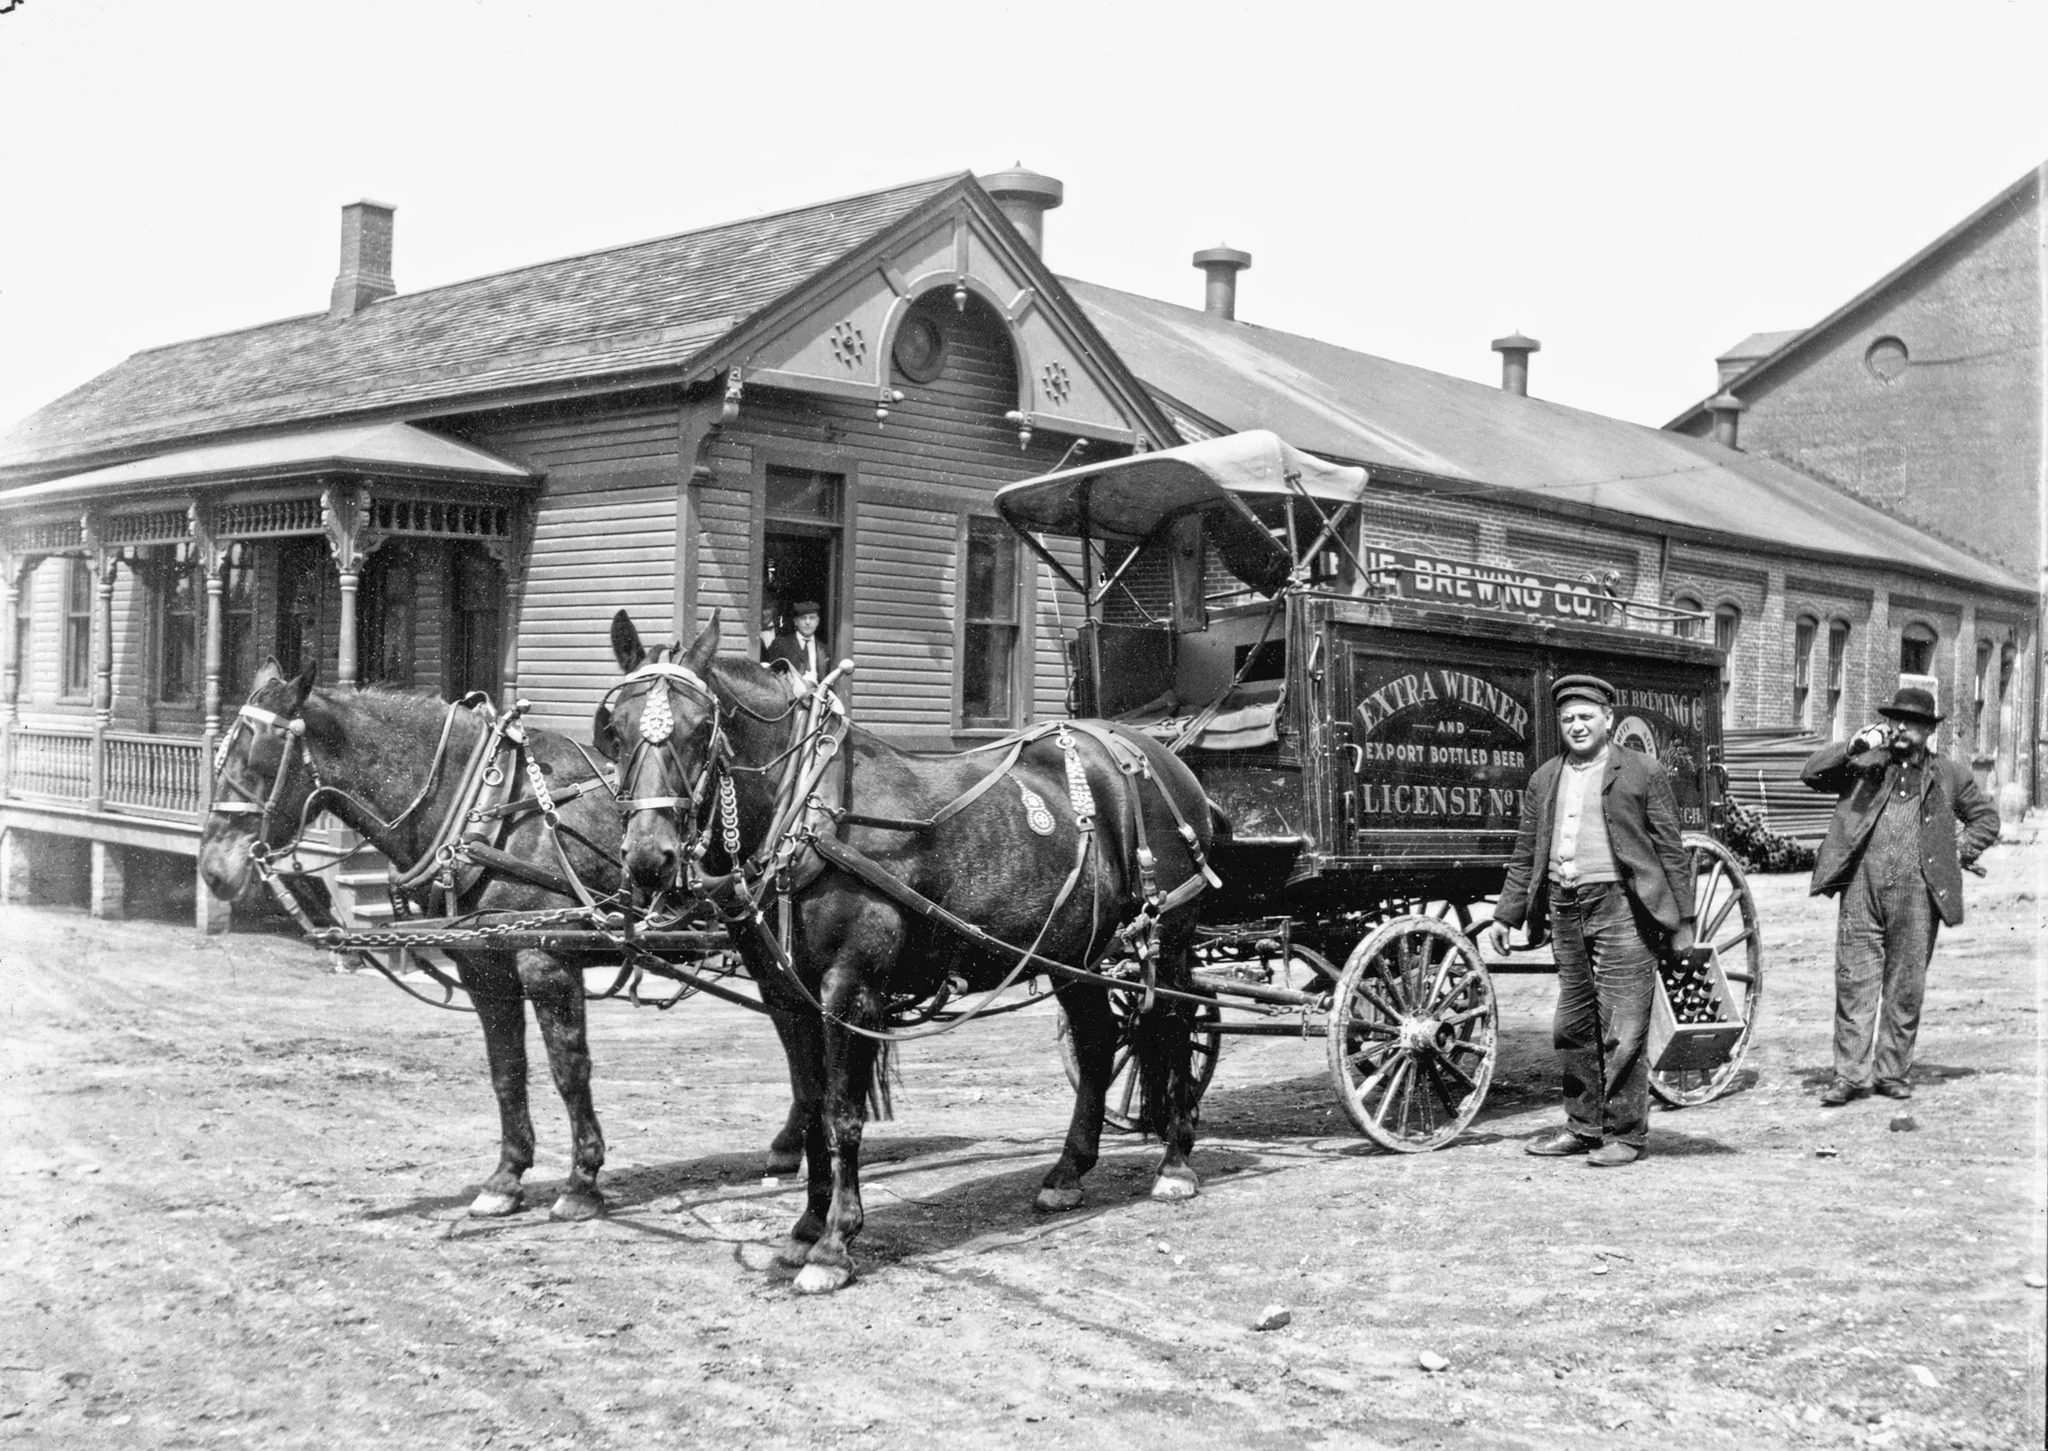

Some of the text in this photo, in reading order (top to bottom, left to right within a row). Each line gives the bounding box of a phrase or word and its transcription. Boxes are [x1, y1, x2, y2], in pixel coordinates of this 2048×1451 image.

[1415, 559, 1543, 608] BREWING
[1554, 583, 1597, 617] CO.
[1357, 670, 1528, 739] EXTRA WIENER
[1631, 690, 1689, 727] BREWING
[1437, 721, 1465, 734] AND
[1365, 743, 1525, 768] EXPORT BOTTLED BEER
[1363, 784, 1482, 816] LICENSE
